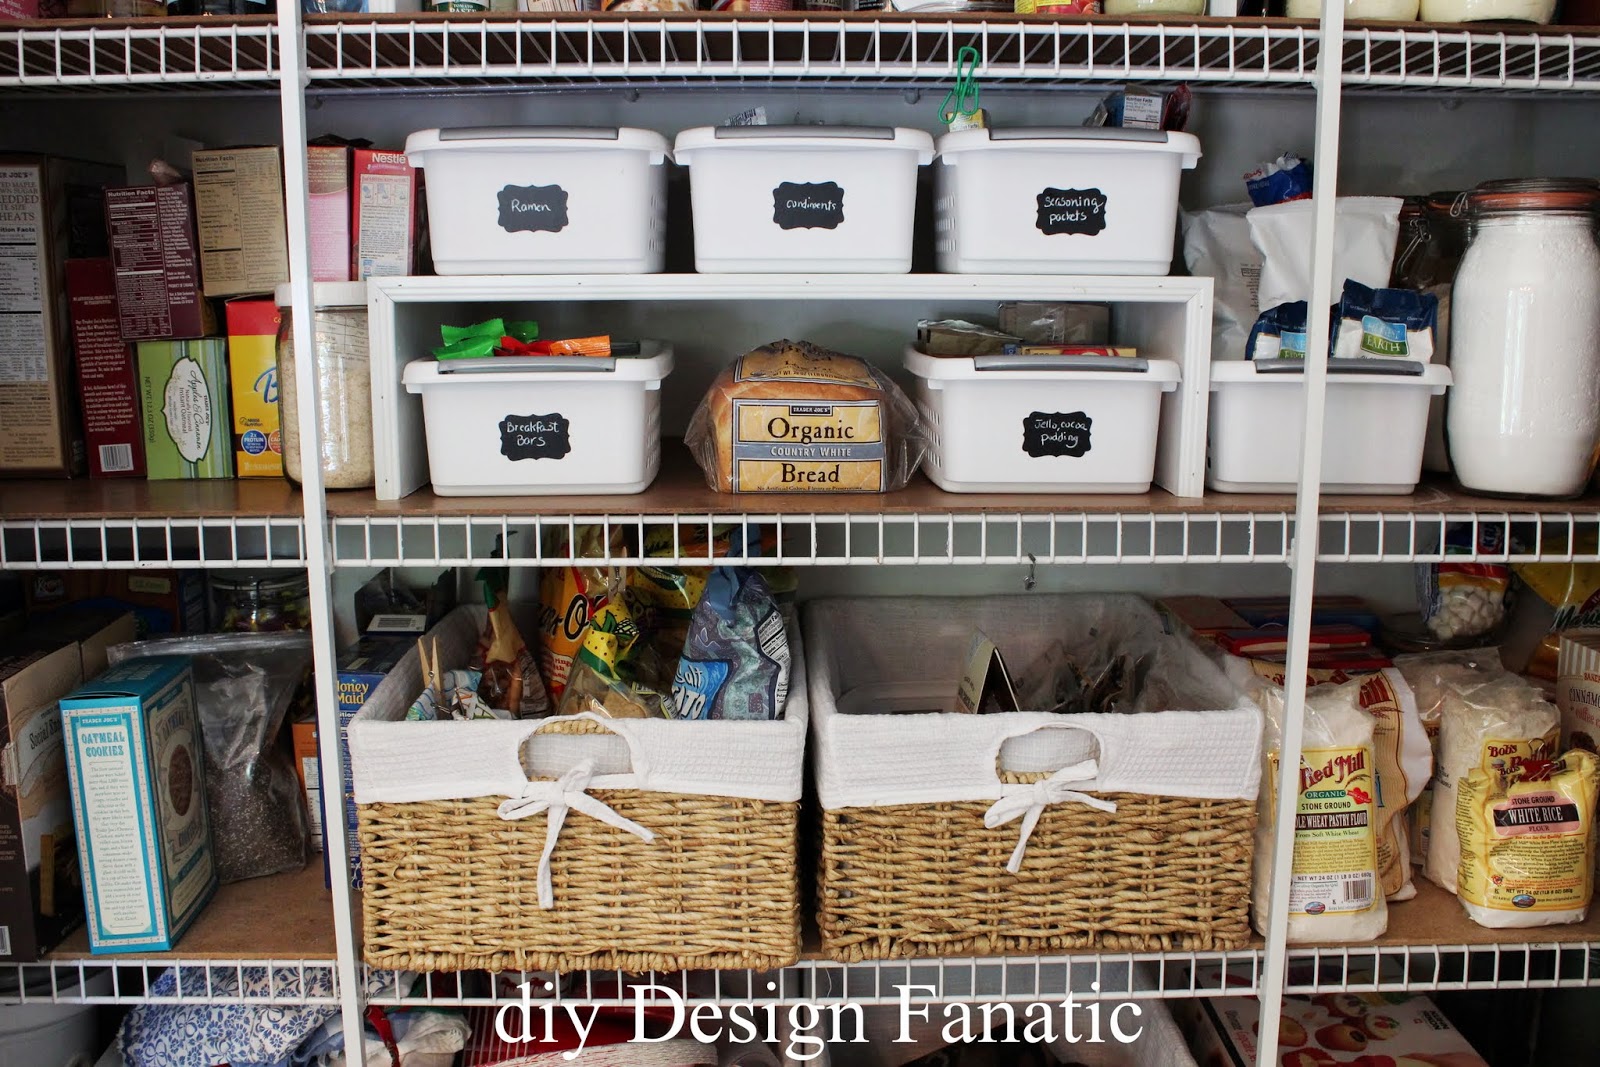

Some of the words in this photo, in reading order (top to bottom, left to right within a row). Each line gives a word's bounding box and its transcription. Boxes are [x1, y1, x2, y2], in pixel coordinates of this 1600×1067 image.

[511, 198, 552, 213] Ramen
[1367, 335, 1401, 352] EARTH
[506, 420, 560, 433] Breakfast
[767, 417, 855, 445] Organic
[516, 434, 546, 447] Bars
[1040, 431, 1079, 449] pudding
[770, 446, 816, 457] COUNTRY
[819, 446, 852, 457] WHITE
[781, 463, 840, 483] Bread
[81, 731, 126, 744] OATMEAL
[85, 745, 124, 757] COOKIES
[1487, 744, 1518, 758] Bob's
[1334, 748, 1366, 783] Mill
[1305, 790, 1345, 799] ORGANIC
[1511, 797, 1531, 805] STONE
[1531, 795, 1556, 804] GROUND
[1301, 802, 1322, 811] STONE
[1323, 801, 1352, 809] GROUND
[1306, 814, 1329, 828] WHEAT
[1328, 813, 1351, 827] PASTRY
[1350, 812, 1368, 825] FLOUR
[1508, 807, 1541, 824] WHITE
[1541, 806, 1564, 821] RICE
[1295, 830, 1311, 838] From
[1312, 830, 1324, 838] Soft
[1325, 829, 1342, 837] White
